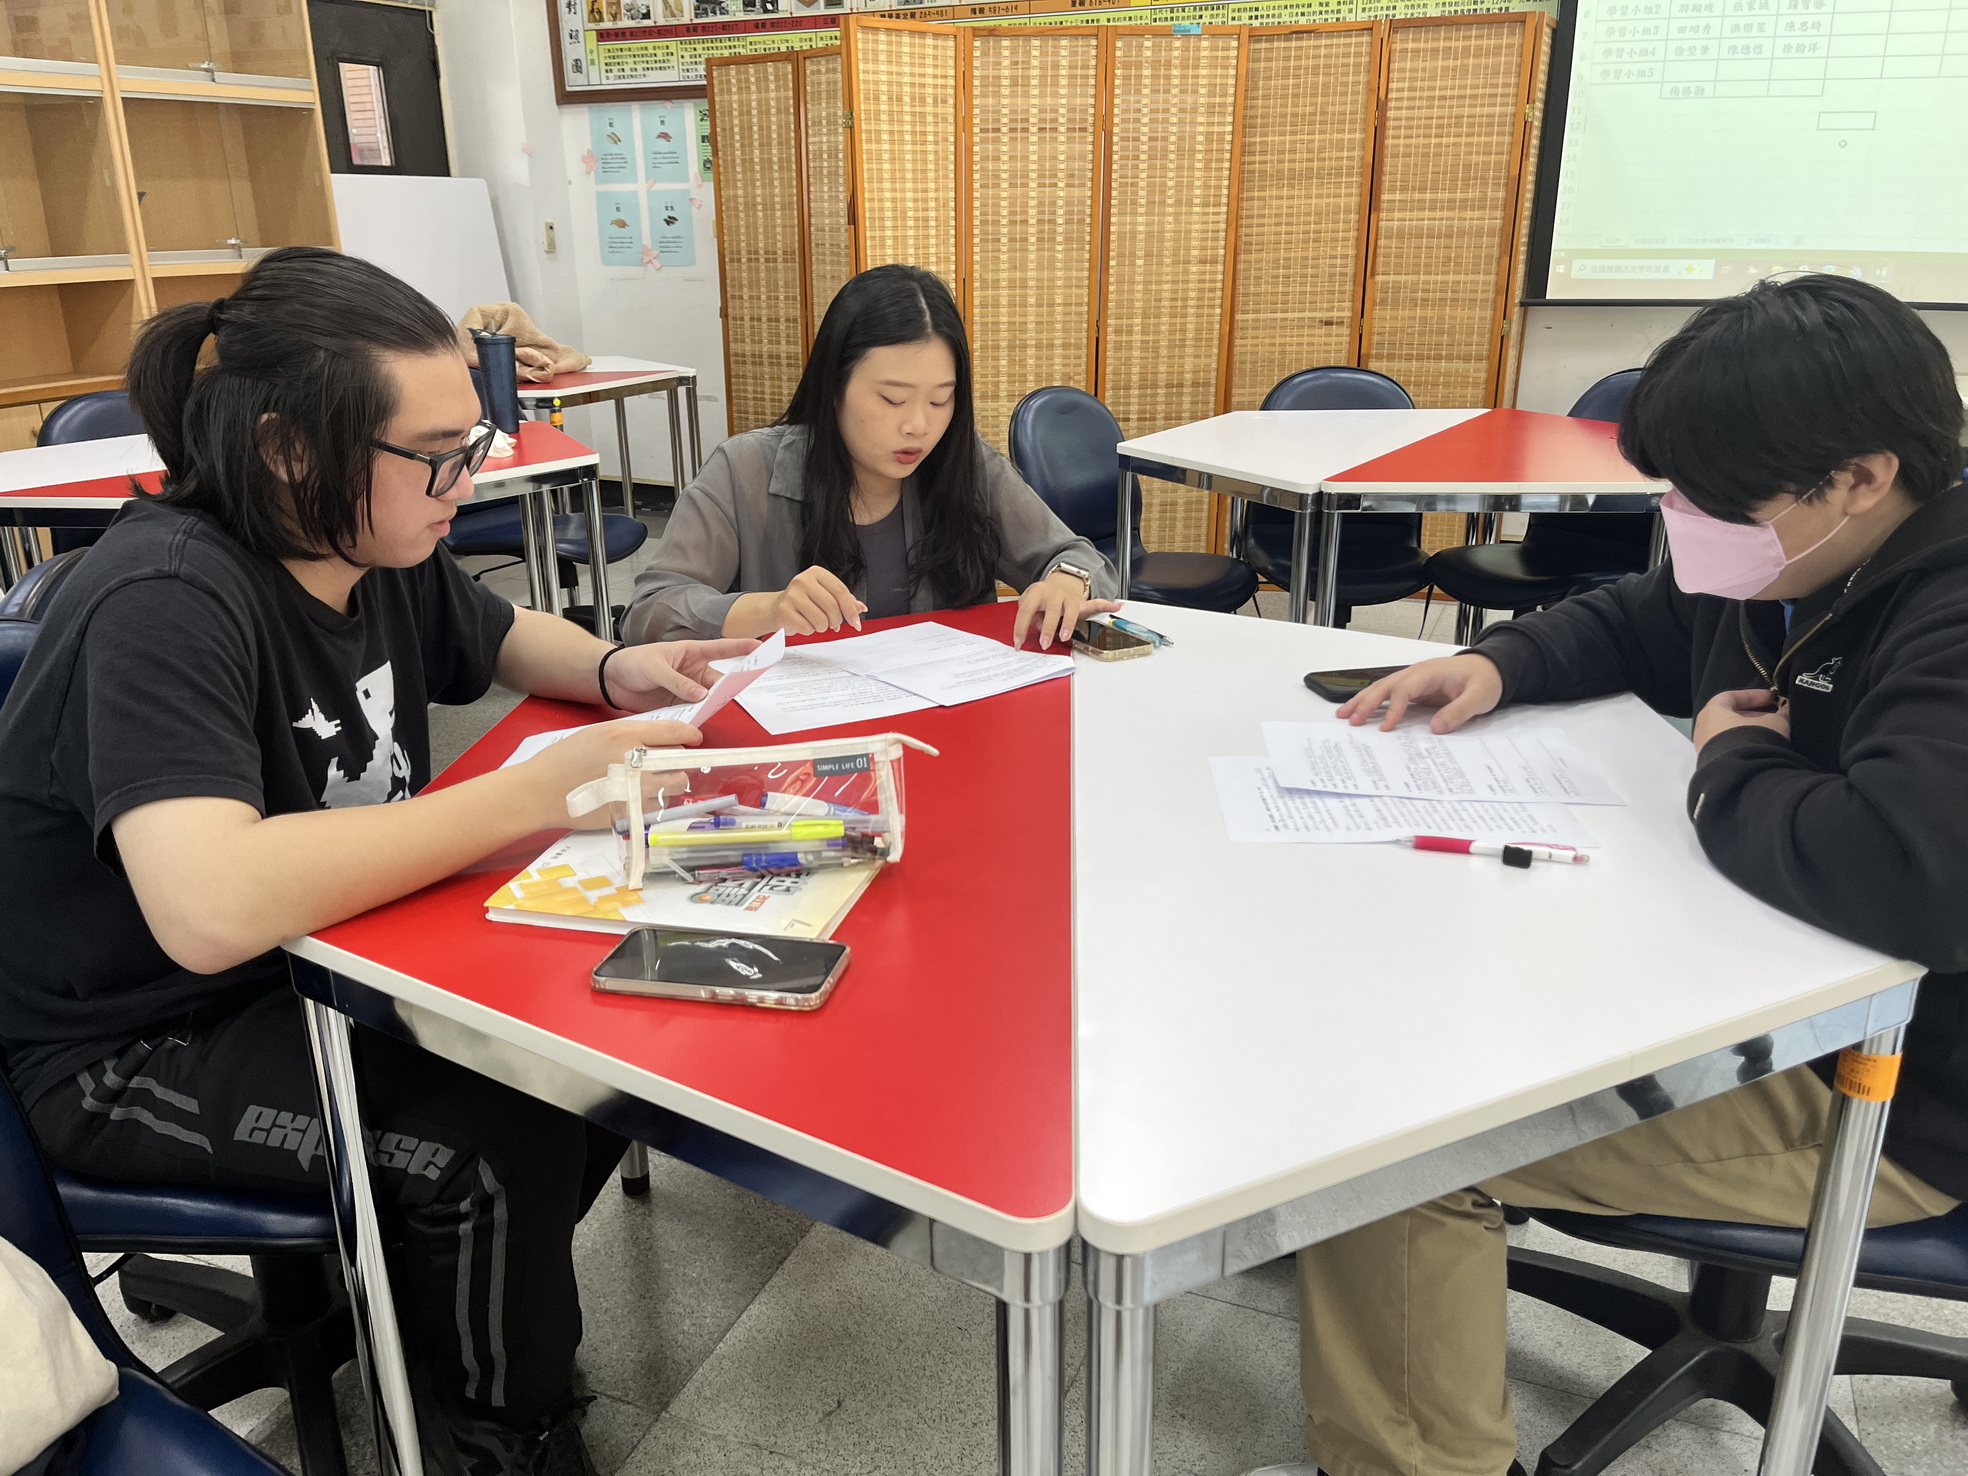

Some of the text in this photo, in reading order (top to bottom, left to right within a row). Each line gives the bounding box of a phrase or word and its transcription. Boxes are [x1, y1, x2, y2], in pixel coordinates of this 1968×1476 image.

[1798, 677, 1831, 691] KANGOL
[816, 757, 868, 772] SIMPLE LIFE 01
[233, 1104, 456, 1181] expse
